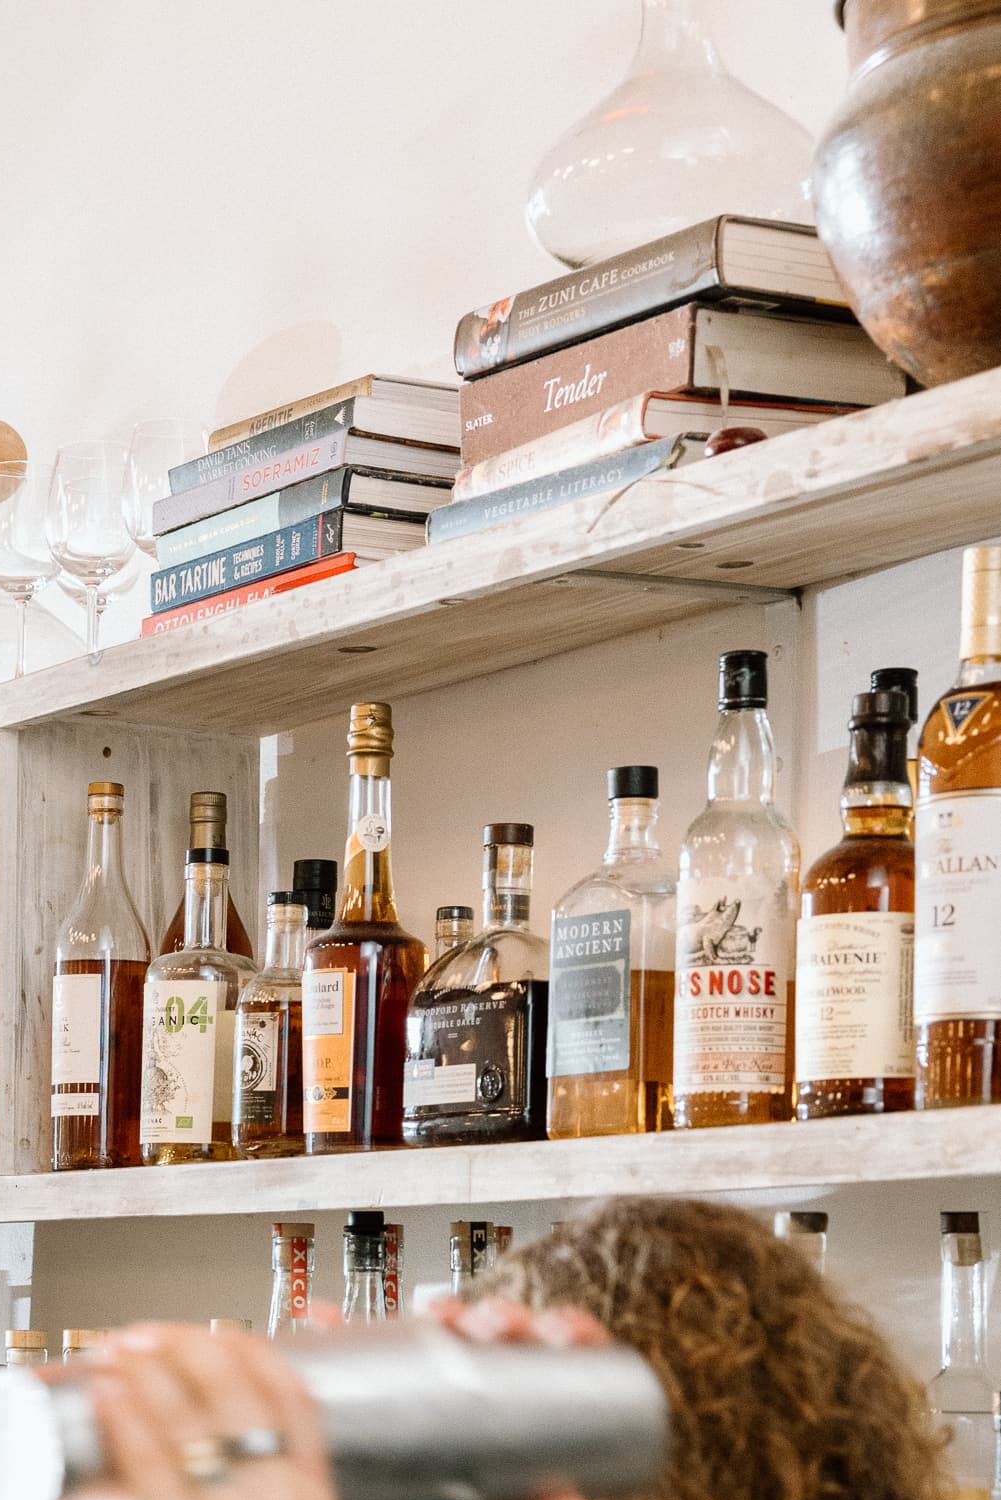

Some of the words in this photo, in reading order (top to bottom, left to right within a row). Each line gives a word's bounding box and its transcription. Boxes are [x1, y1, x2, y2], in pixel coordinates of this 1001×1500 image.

[518, 308, 535, 321] THE
[538, 285, 576, 313] ZUNI
[579, 269, 619, 296] CAFE
[620, 251, 675, 281] COOKBOOK
[543, 309, 587, 331] RODGERS
[543, 363, 608, 413] Tender
[465, 413, 494, 433] SLATER
[197, 450, 225, 472] DAVID
[226, 439, 251, 462] TANIS
[199, 461, 234, 482] MARKET
[233, 445, 277, 472] COOKING
[243, 447, 321, 491] SOFRAMIZ
[497, 451, 536, 481] SPICE
[483, 488, 553, 521] VEGETABLE
[559, 466, 626, 498] LITERACY
[232, 543, 265, 565] TECHNIQUES
[155, 572, 177, 606] BAR
[179, 557, 227, 597] TARTINE
[233, 567, 241, 581] &
[240, 559, 263, 579] RECIPES
[953, 701, 972, 716] 12
[556, 918, 624, 942] MODERN
[932, 903, 956, 928] 12
[556, 937, 623, 960] ANCIENT
[708, 968, 777, 997] NOSE
[165, 996, 214, 1034] 04
[691, 1006, 730, 1020] SCOTCH
[734, 1006, 776, 1020] WHISKY
[819, 1006, 835, 1022] 12
[293, 1238, 306, 1310] XICO
